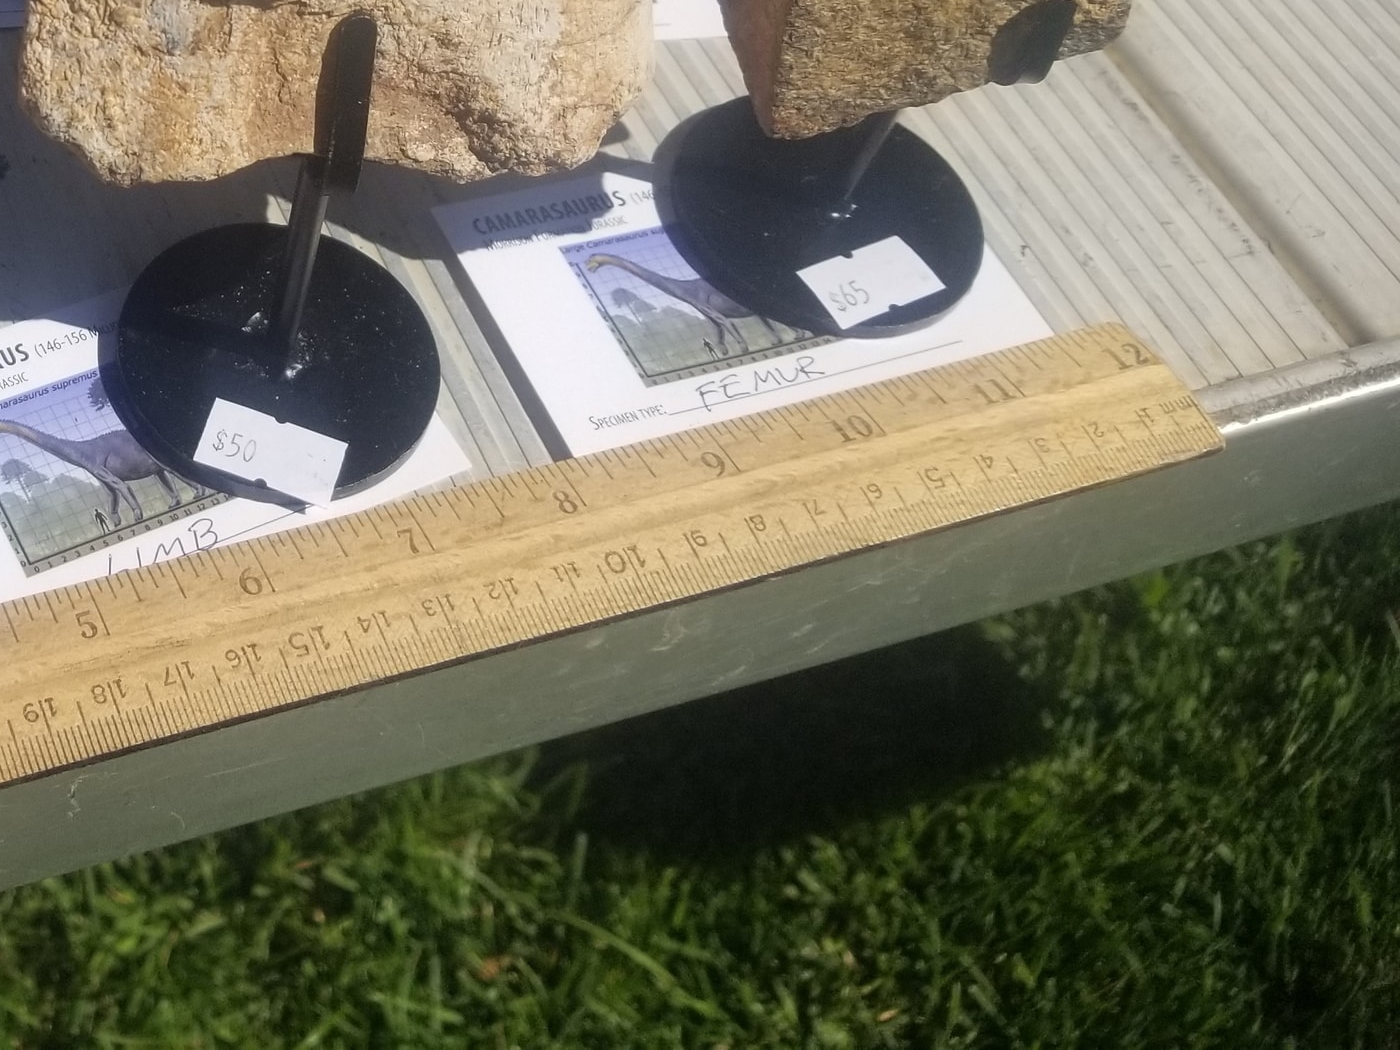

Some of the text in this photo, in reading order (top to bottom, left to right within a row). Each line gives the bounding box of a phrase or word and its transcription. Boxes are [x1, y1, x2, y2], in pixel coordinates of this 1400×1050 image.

[472, 190, 627, 236] CAMARASAURUS
[828, 280, 870, 312] $65
[34, 331, 88, 359] (146-156
[51, 369, 99, 393] supremus
[694, 355, 826, 412] FEMUR
[589, 404, 668, 431] SPECIMEN TYPE:
[1143, 406, 1154, 422] 1
[1090, 420, 1104, 438] 2
[212, 428, 257, 463] $50
[1034, 436, 1049, 453] 3
[980, 452, 995, 470] 4
[75, 609, 99, 639] 5
[238, 566, 263, 596] 6
[396, 527, 420, 554] 7
[551, 490, 578, 515] 8
[700, 451, 726, 478] 9
[828, 414, 874, 443] 10
[970, 377, 1017, 405] 11
[1104, 341, 1149, 371] 12
[868, 481, 883, 500] 6
[924, 466, 946, 490] 5
[812, 499, 827, 517] 7
[749, 513, 767, 532] 8
[691, 529, 708, 548] 9
[550, 561, 582, 583] 11
[604, 544, 647, 575] 10
[482, 576, 519, 600] 12
[421, 593, 456, 617] 13
[356, 609, 392, 634] 14
[287, 624, 332, 658] 15
[224, 642, 262, 669] 16
[163, 659, 196, 687] 17
[90, 678, 127, 705] 18
[21, 696, 59, 723] 19
